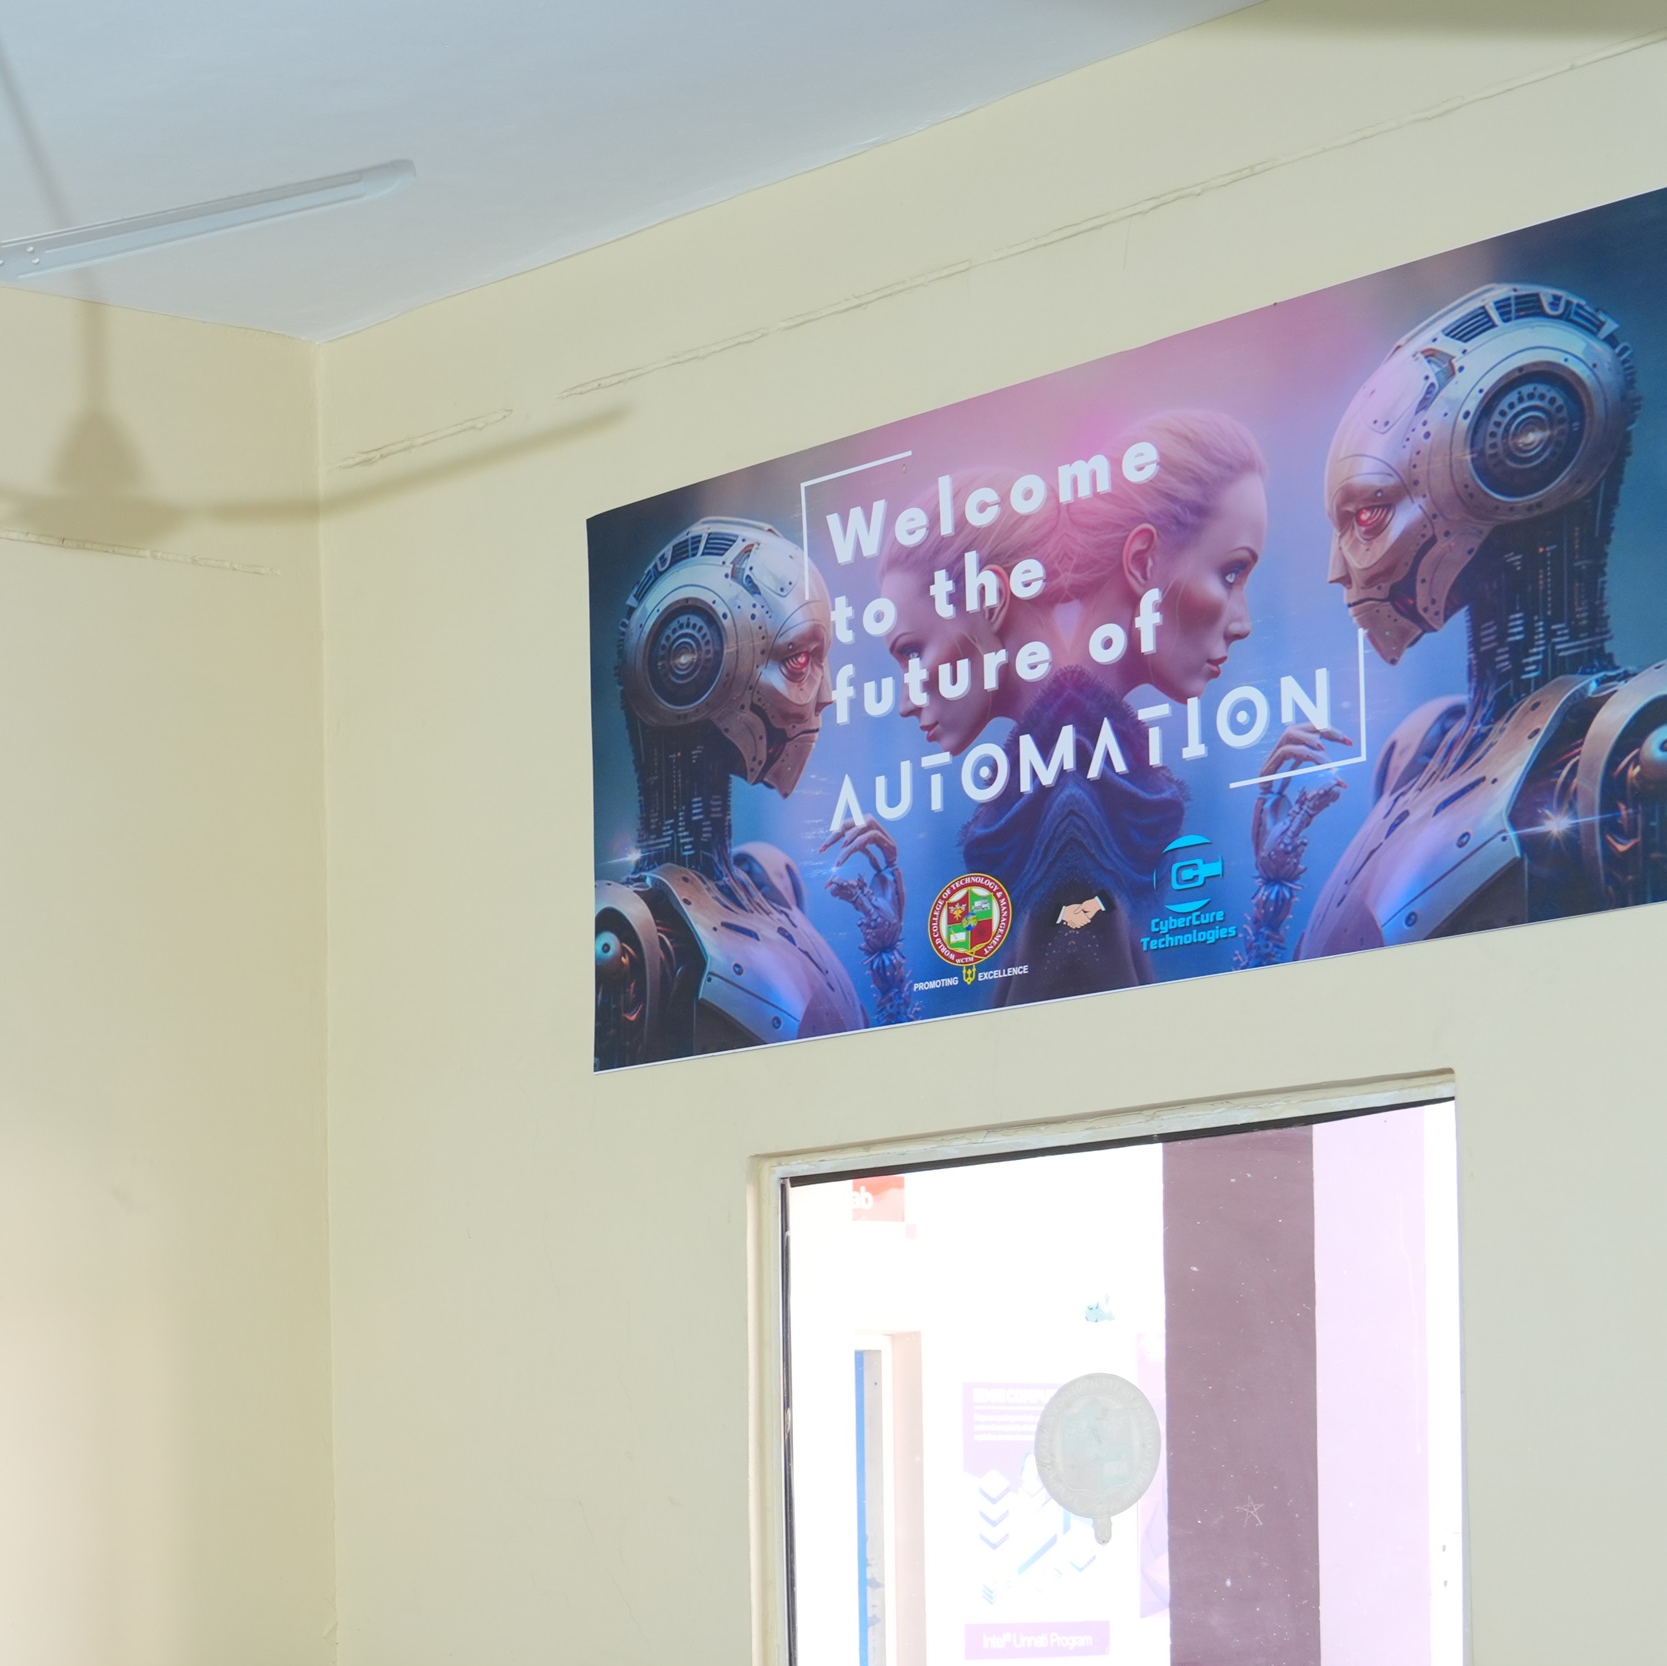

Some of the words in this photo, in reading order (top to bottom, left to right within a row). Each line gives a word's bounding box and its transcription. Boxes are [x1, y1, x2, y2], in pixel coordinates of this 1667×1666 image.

[826, 441, 1161, 565] Welcome
[830, 596, 897, 645] to
[929, 551, 1046, 620] the
[832, 640, 1052, 726] future
[1088, 588, 1164, 665] of
[829, 668, 1332, 832] AUTOMATION
[951, 875, 1000, 894] TECHNOLOGY
[1151, 910, 1224, 932] CyberCure
[1140, 925, 1237, 951] Technologies
[913, 976, 959, 992] PROMOTING
[978, 965, 1029, 982] EXCELLENCE
[1050, 1631, 1093, 1650] Program
